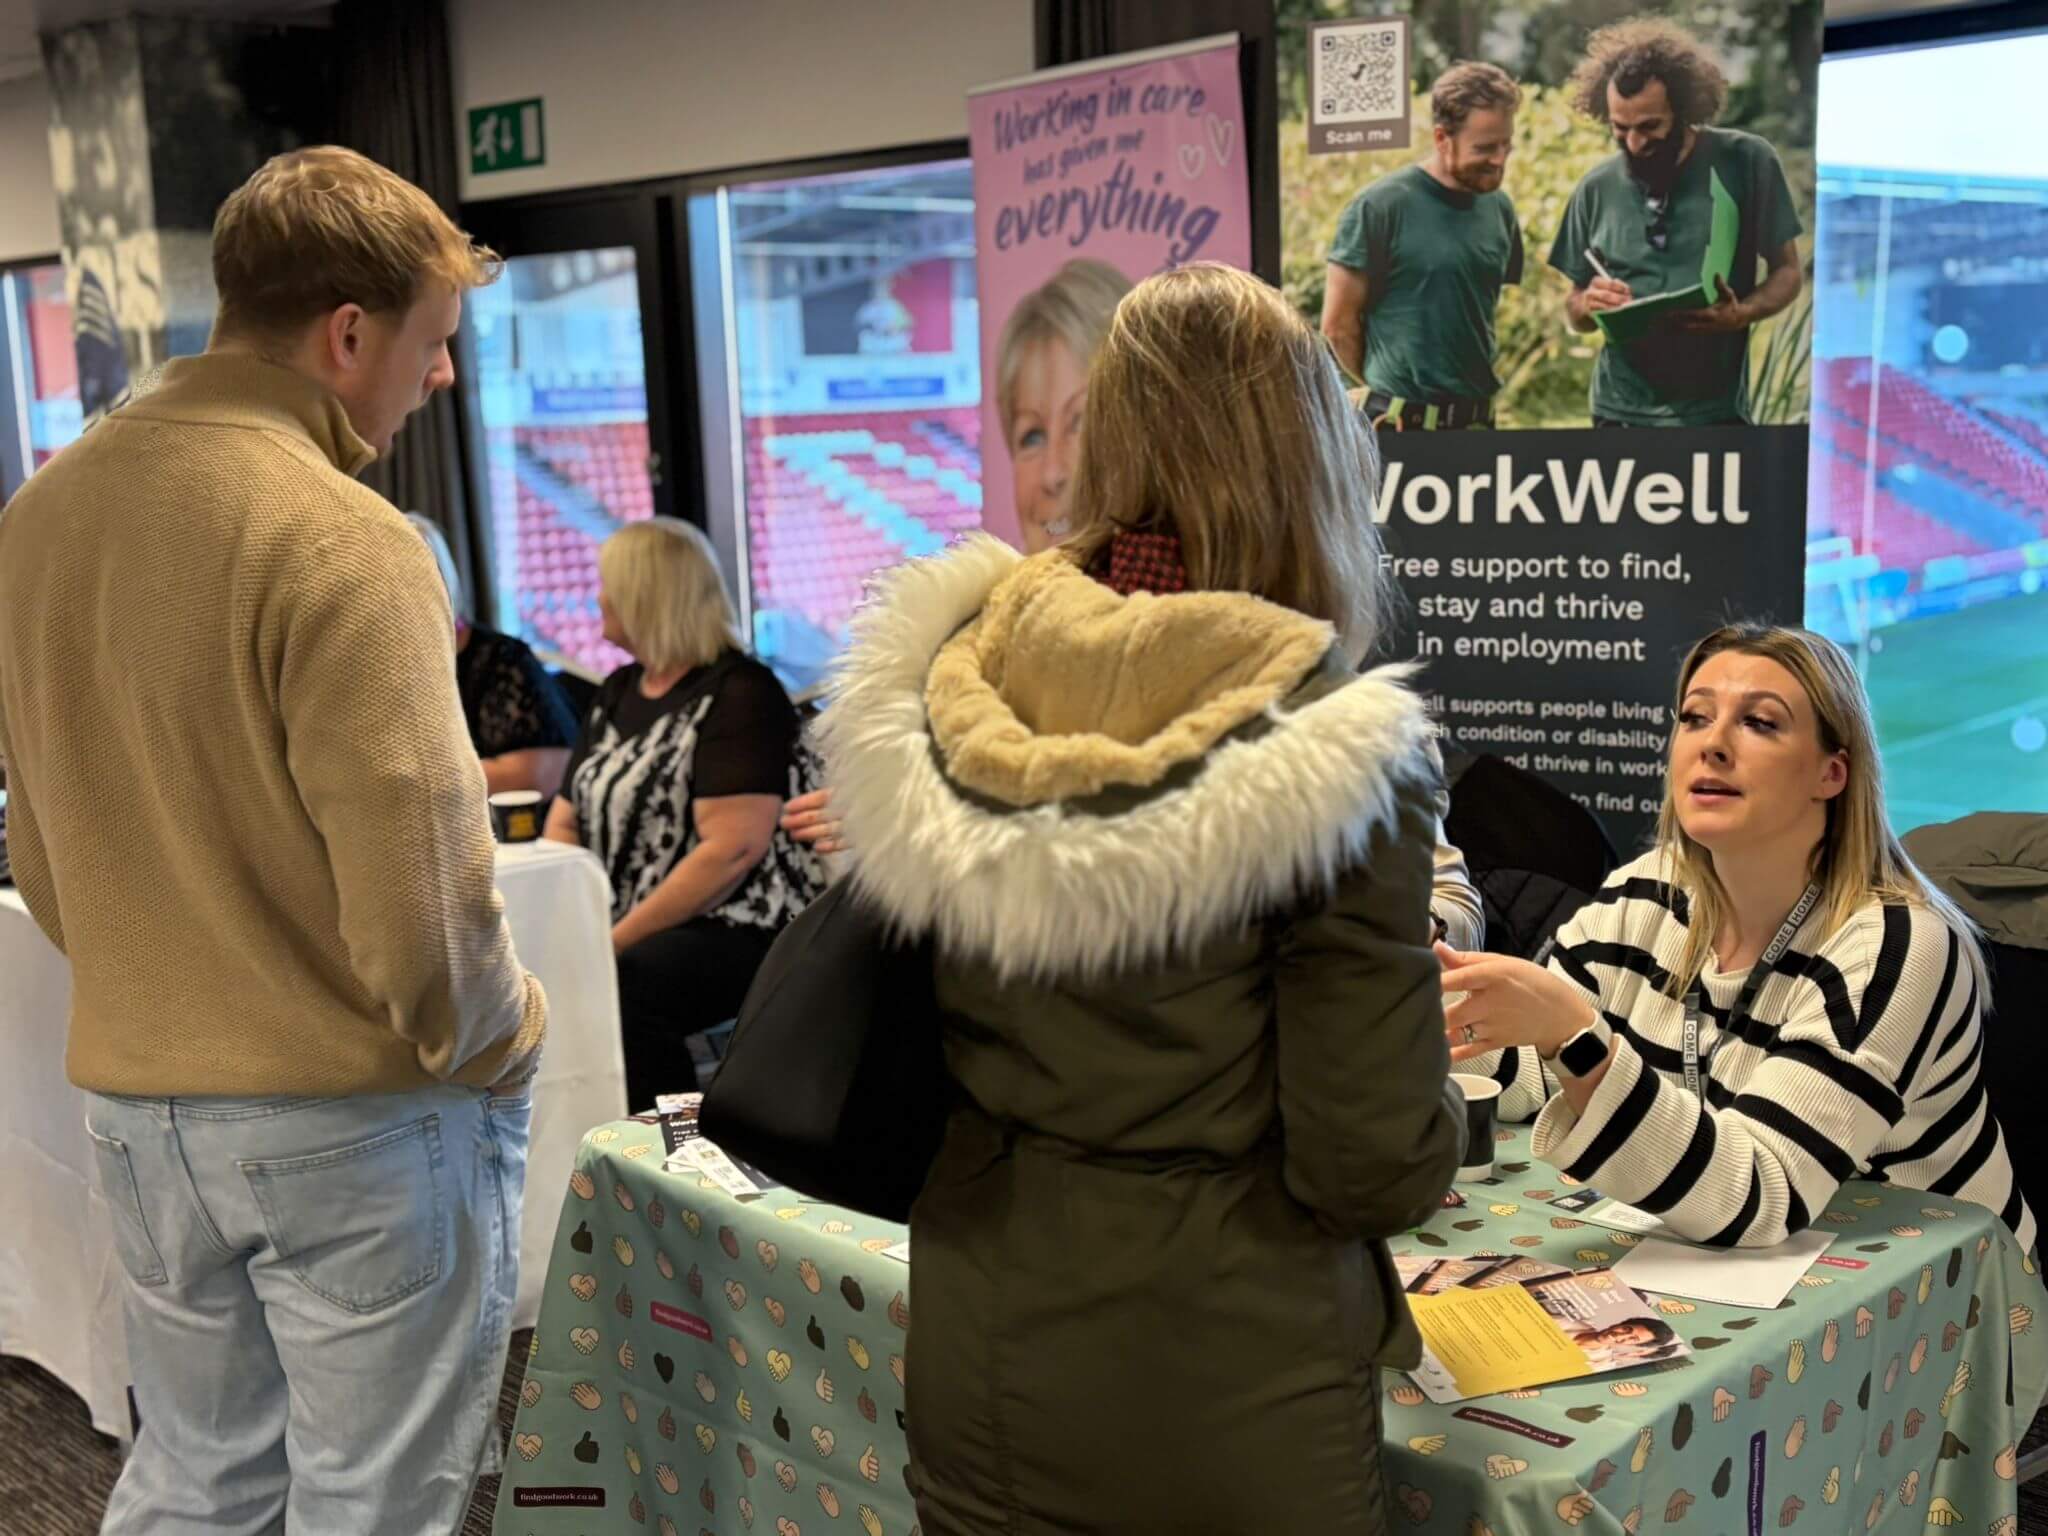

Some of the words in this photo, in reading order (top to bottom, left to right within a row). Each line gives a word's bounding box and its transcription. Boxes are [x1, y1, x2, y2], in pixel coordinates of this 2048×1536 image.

[994, 91, 1099, 151] Working
[1106, 77, 1133, 117] in
[1140, 83, 1206, 117] care
[1325, 130, 1364, 145] Scan
[1367, 129, 1393, 142] me
[1060, 137, 1107, 179] given
[1114, 129, 1145, 152] me
[994, 158, 1221, 266] everything
[1378, 553, 1440, 578] Free
[1450, 554, 1568, 583] support
[1578, 556, 1610, 579] to
[1620, 553, 1691, 583] find,
[1418, 594, 1480, 622] stay
[1489, 593, 1545, 619] and
[1556, 593, 1644, 620] thrive
[1417, 631, 1443, 656] in
[1454, 632, 1646, 664] employment
[1450, 698, 1535, 717] supports
[1540, 700, 1607, 720] people
[1612, 701, 1665, 725] living
[1456, 724, 1546, 744] condition
[1552, 730, 1574, 744] or
[1578, 727, 1668, 753] disability
[1503, 752, 1528, 769] nd
[1534, 754, 1590, 773] thrive
[1595, 756, 1614, 774] in
[1619, 760, 1668, 777] work
[1596, 792, 1634, 812] find
[1640, 799, 1664, 813] ou
[1764, 927, 1793, 961] COME
[1791, 886, 1819, 923] HOME
[1686, 1023, 1696, 1061] COME
[1687, 1068, 1698, 1096] HOM
